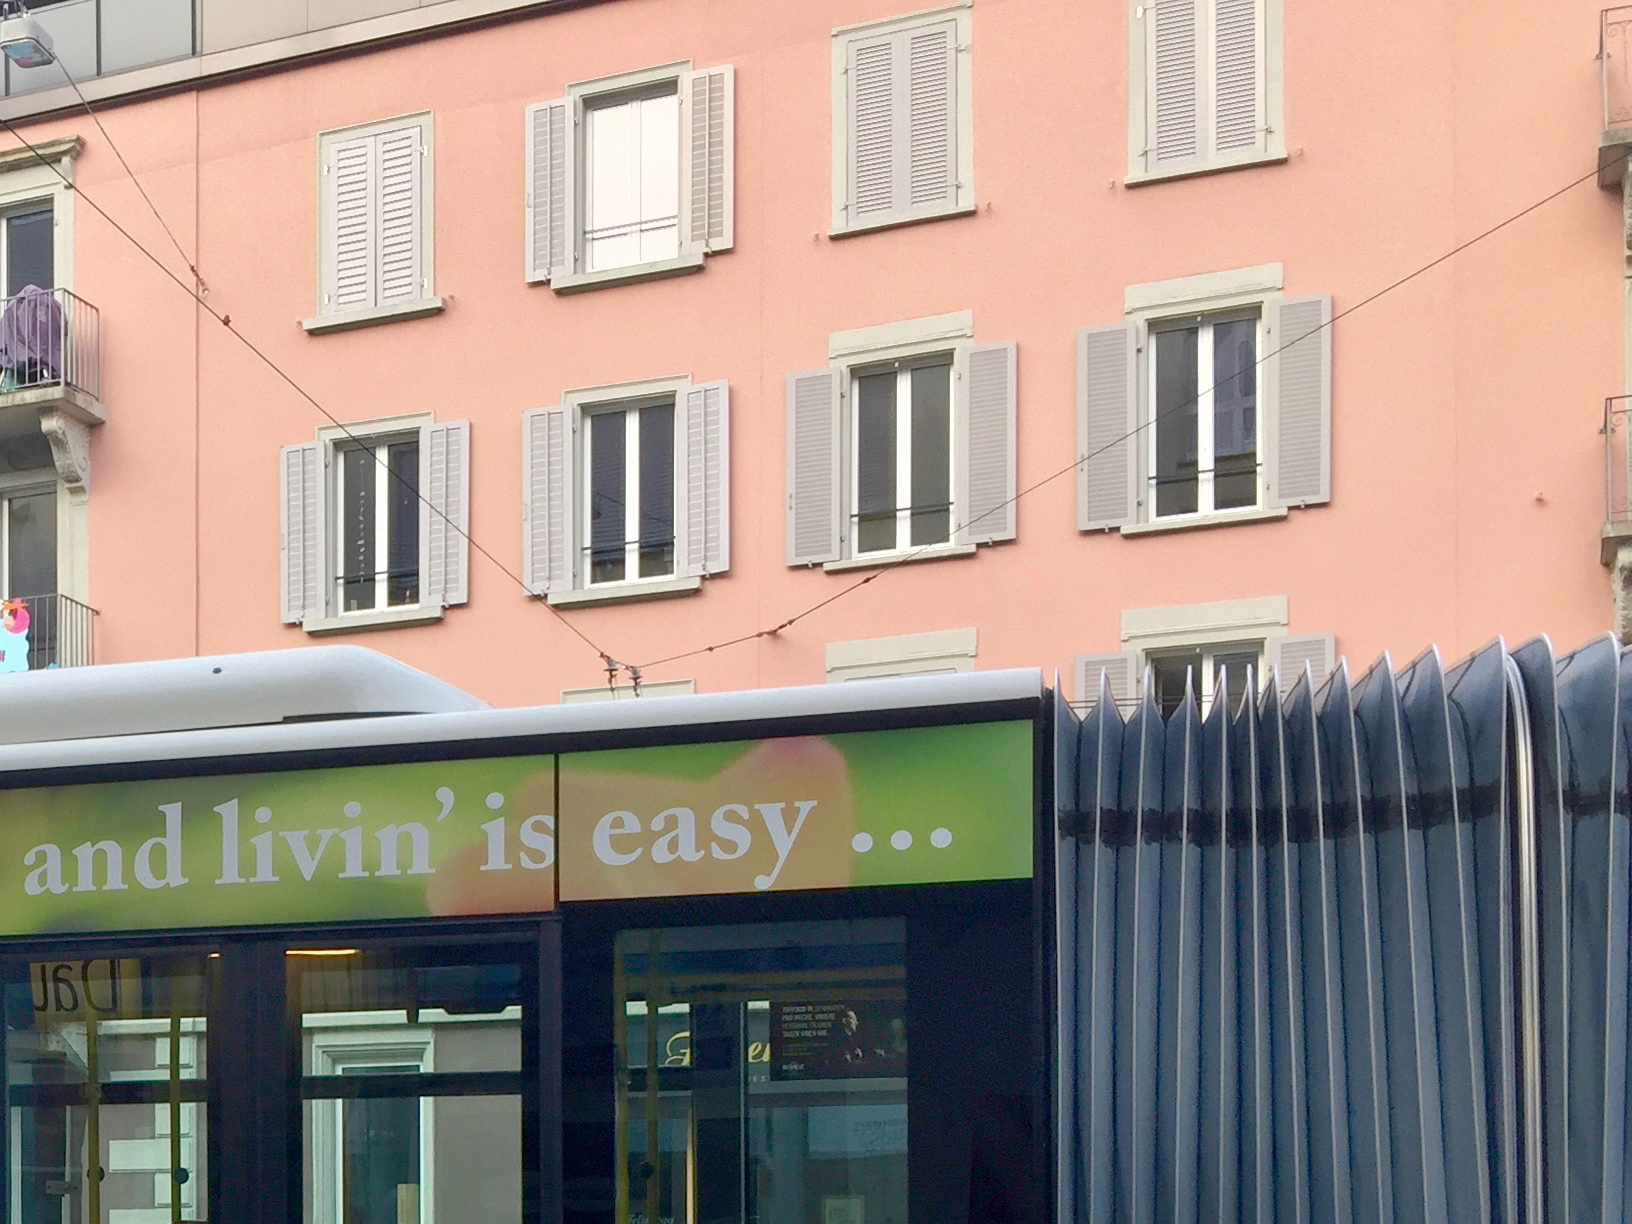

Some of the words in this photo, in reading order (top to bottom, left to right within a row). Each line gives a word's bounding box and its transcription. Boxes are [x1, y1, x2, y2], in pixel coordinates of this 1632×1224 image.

[22, 801, 190, 897] and
[479, 790, 556, 871] is
[592, 799, 819, 891] easy
